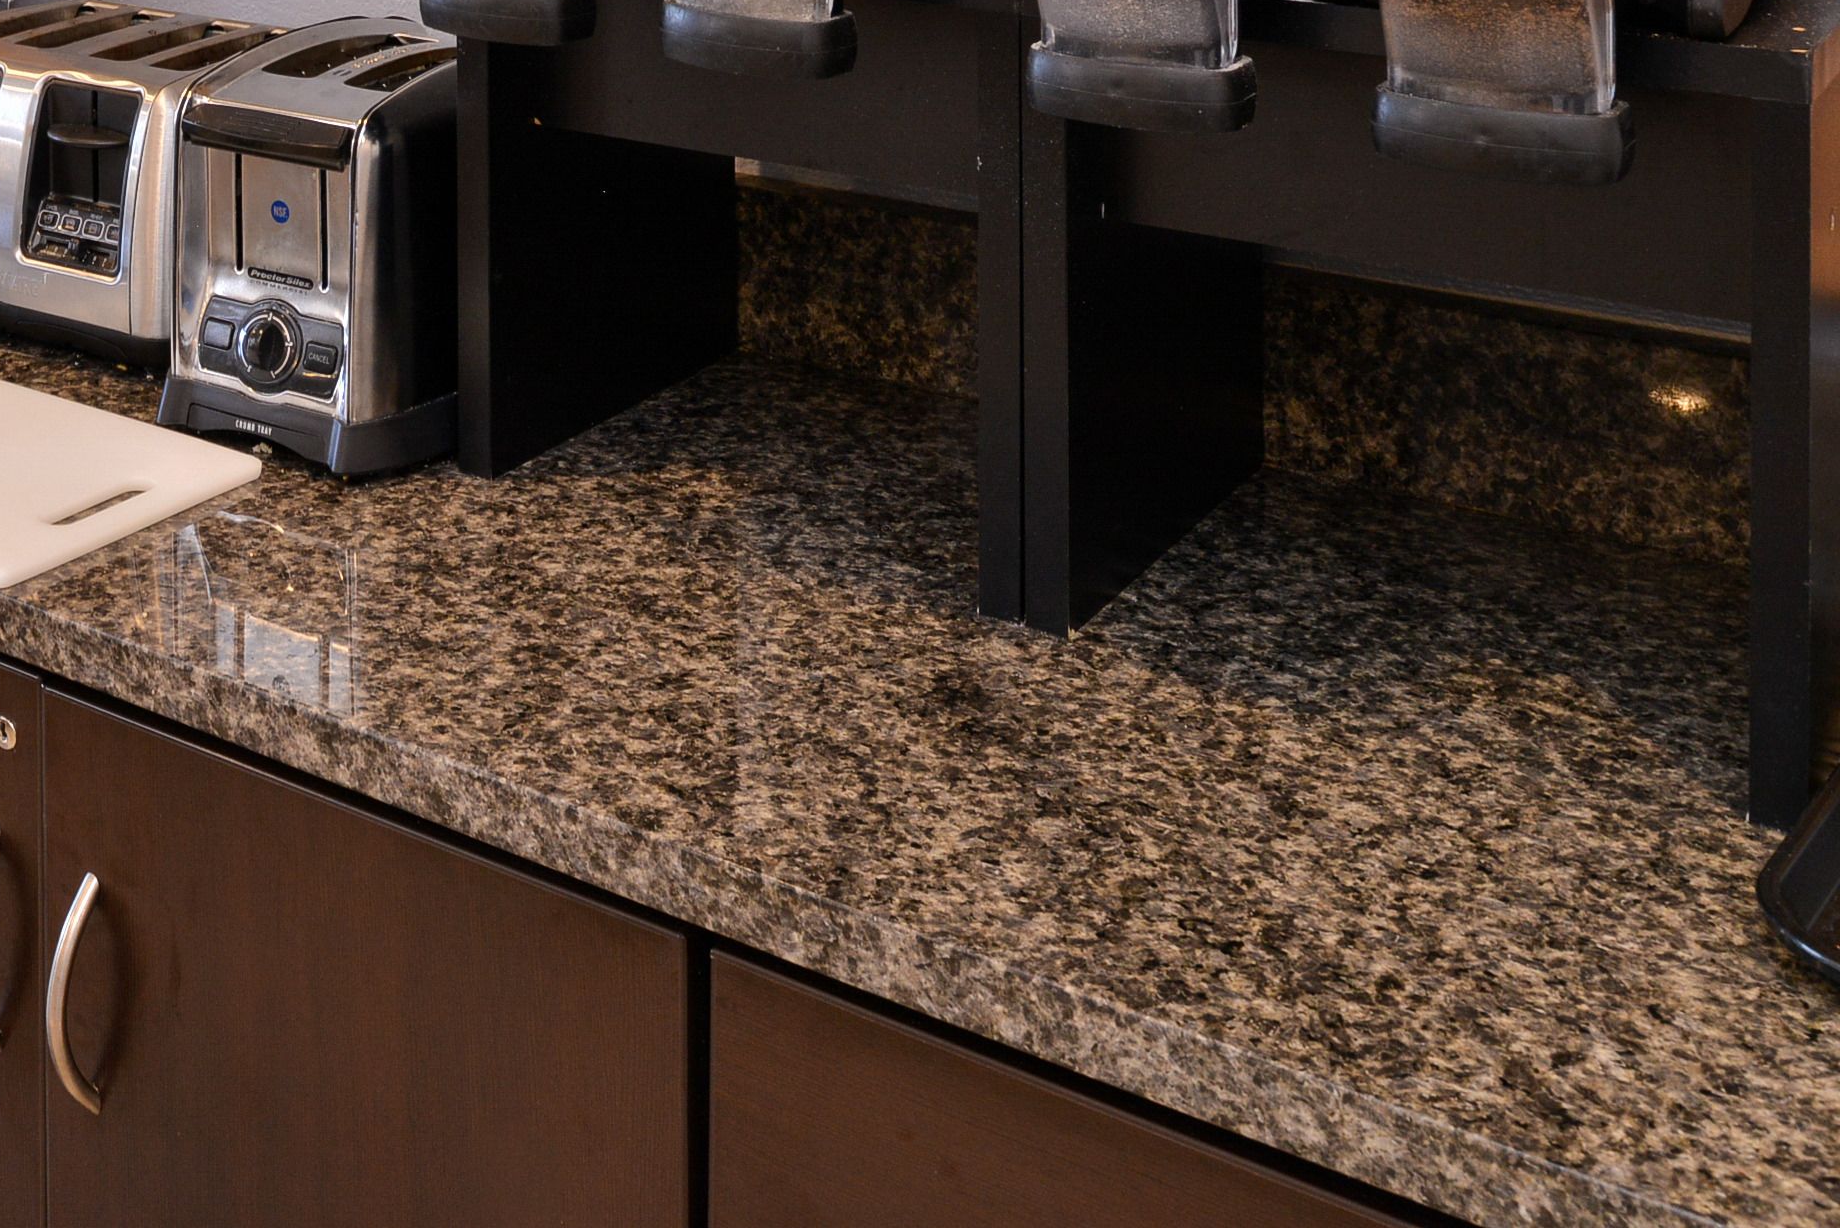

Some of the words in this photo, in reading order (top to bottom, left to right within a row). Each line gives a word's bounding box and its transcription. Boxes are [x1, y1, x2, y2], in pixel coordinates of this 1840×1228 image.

[273, 205, 287, 218] NSF
[308, 352, 330, 365] CANCEL
[235, 419, 256, 432] CRUMB
[257, 425, 273, 436] TRAY
